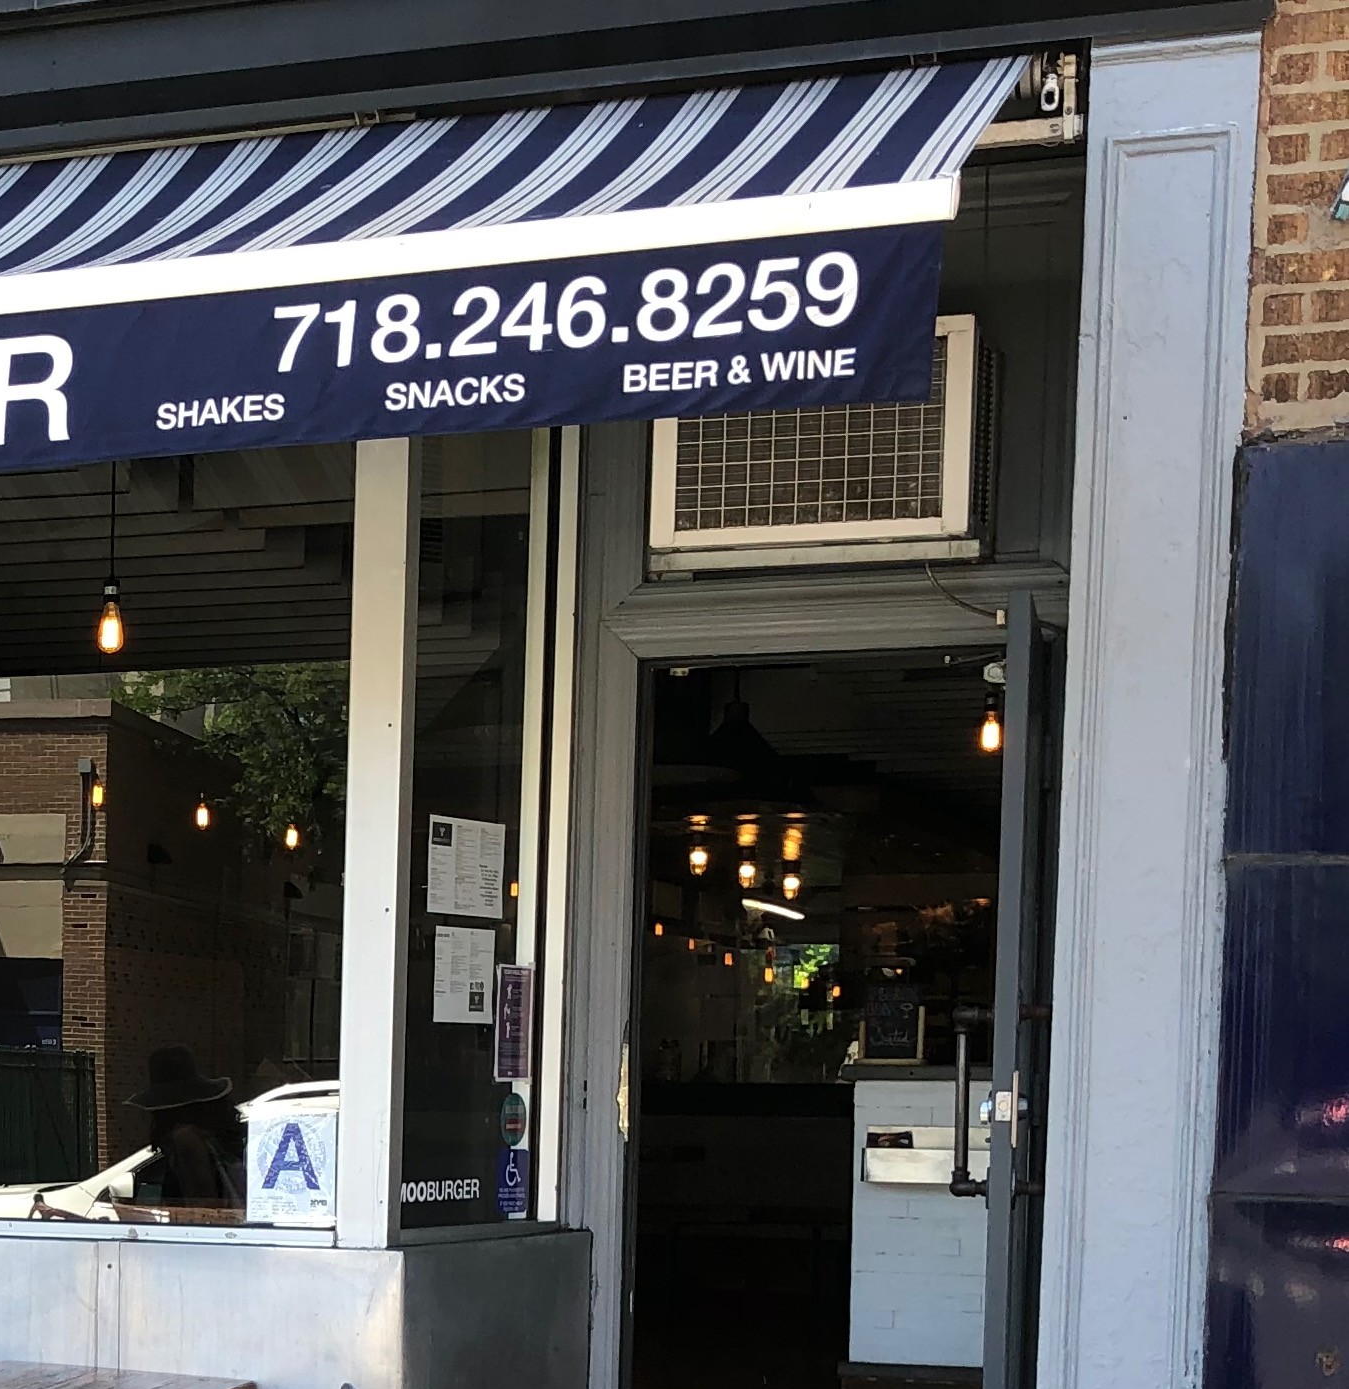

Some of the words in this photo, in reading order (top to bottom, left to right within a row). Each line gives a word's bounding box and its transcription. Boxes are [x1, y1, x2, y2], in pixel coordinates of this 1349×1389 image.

[273, 251, 860, 372] 718.246.8259
[384, 373, 526, 412] SNACKS
[623, 359, 718, 393] BEER
[727, 355, 752, 385] &
[761, 348, 857, 382] WINE
[156, 393, 285, 431] SHAKES
[261, 1123, 320, 1190] A
